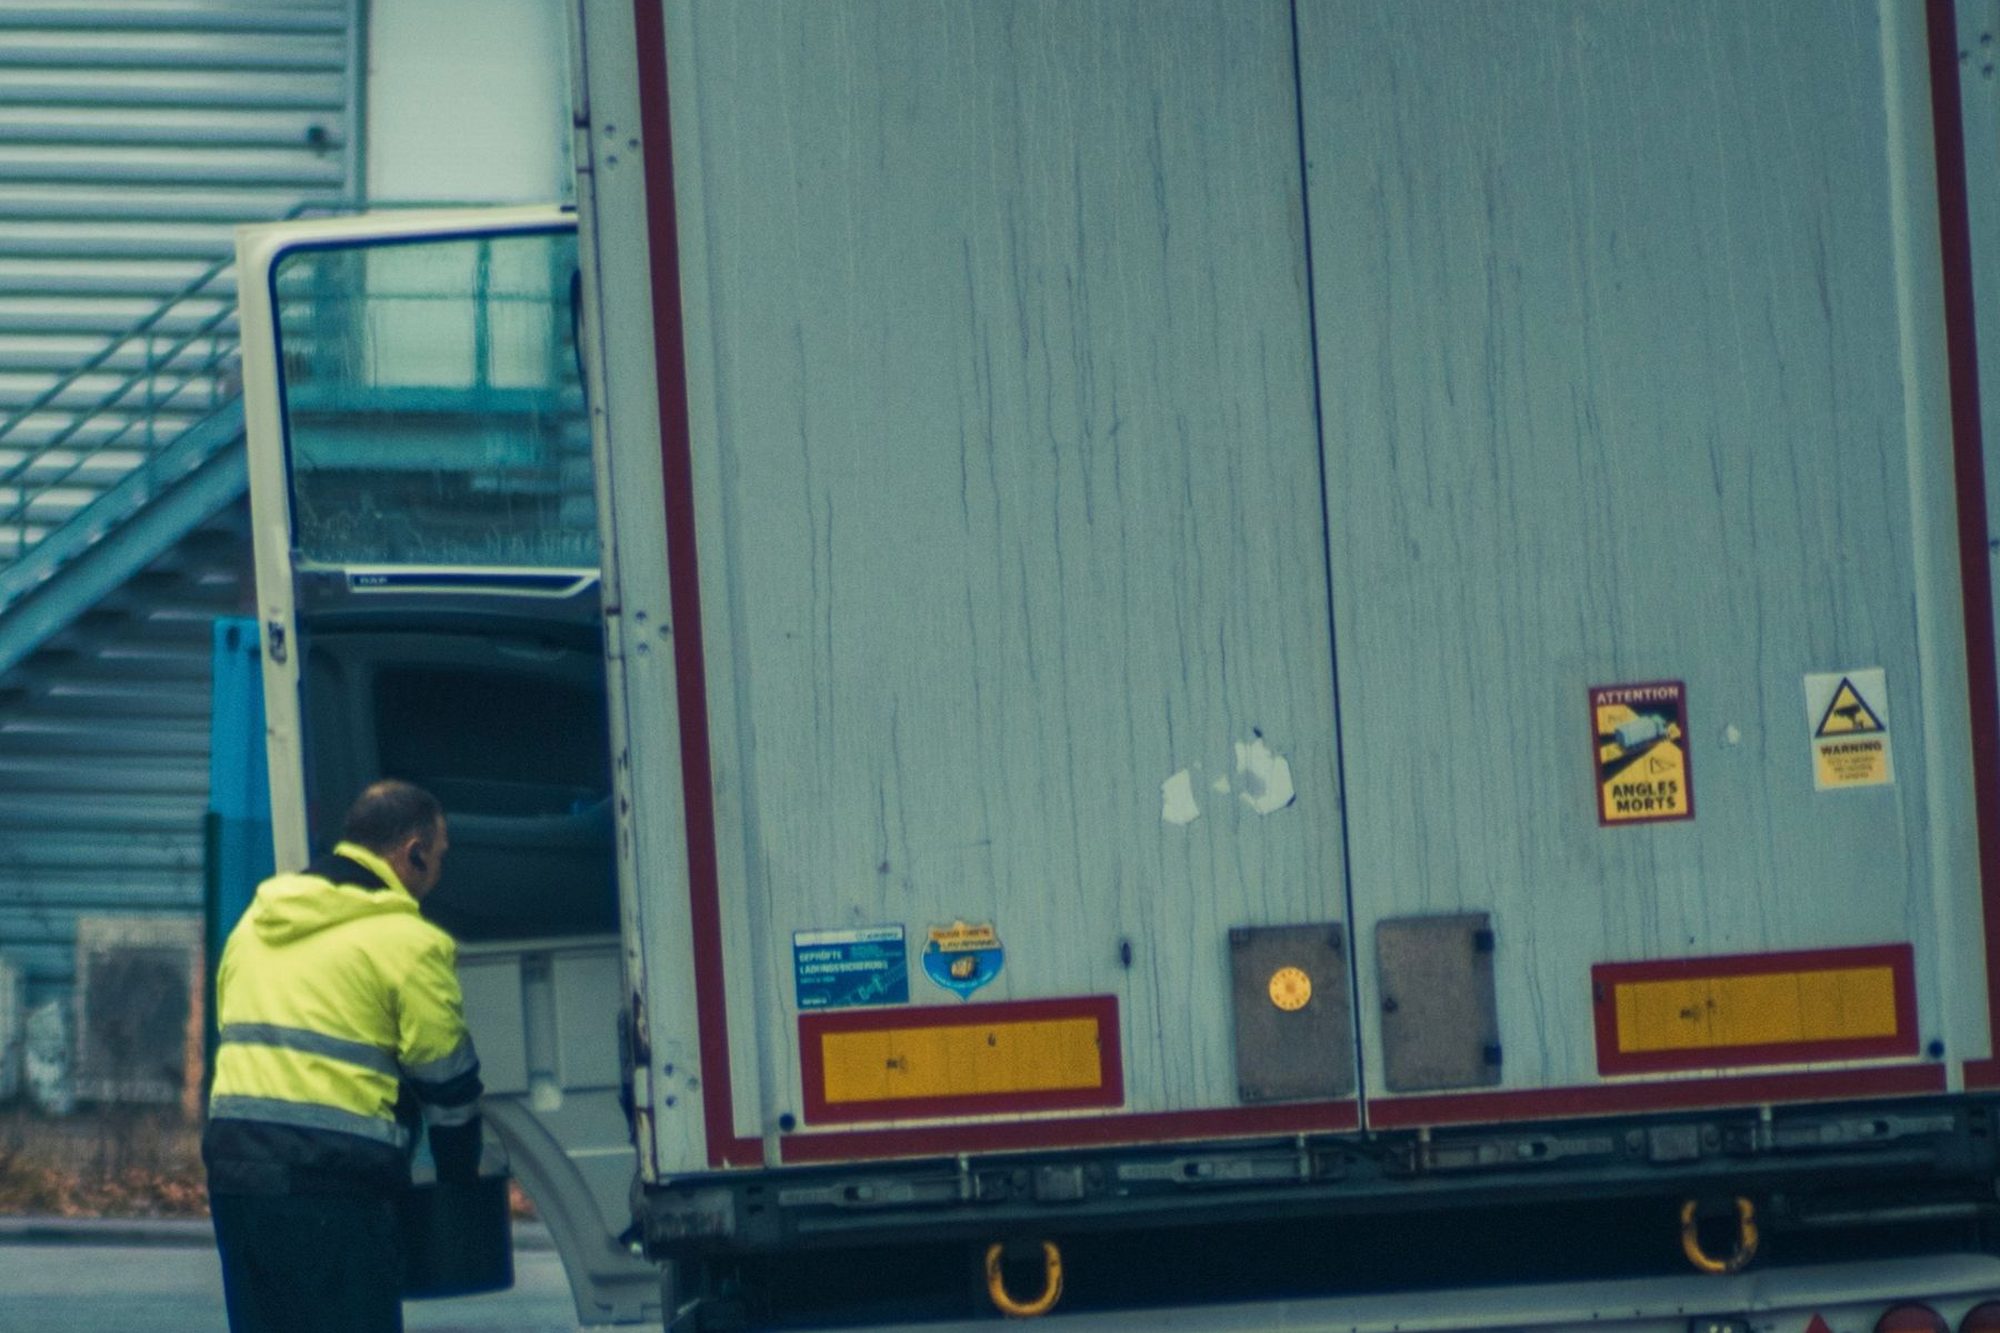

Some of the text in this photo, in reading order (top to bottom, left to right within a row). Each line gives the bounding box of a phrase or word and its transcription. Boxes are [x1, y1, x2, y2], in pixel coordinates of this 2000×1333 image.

[1597, 686, 1679, 703] ATTENTION
[1820, 741, 1882, 756] WARNING
[1613, 780, 1677, 798] ANGLES
[1617, 796, 1676, 812] MORTS
